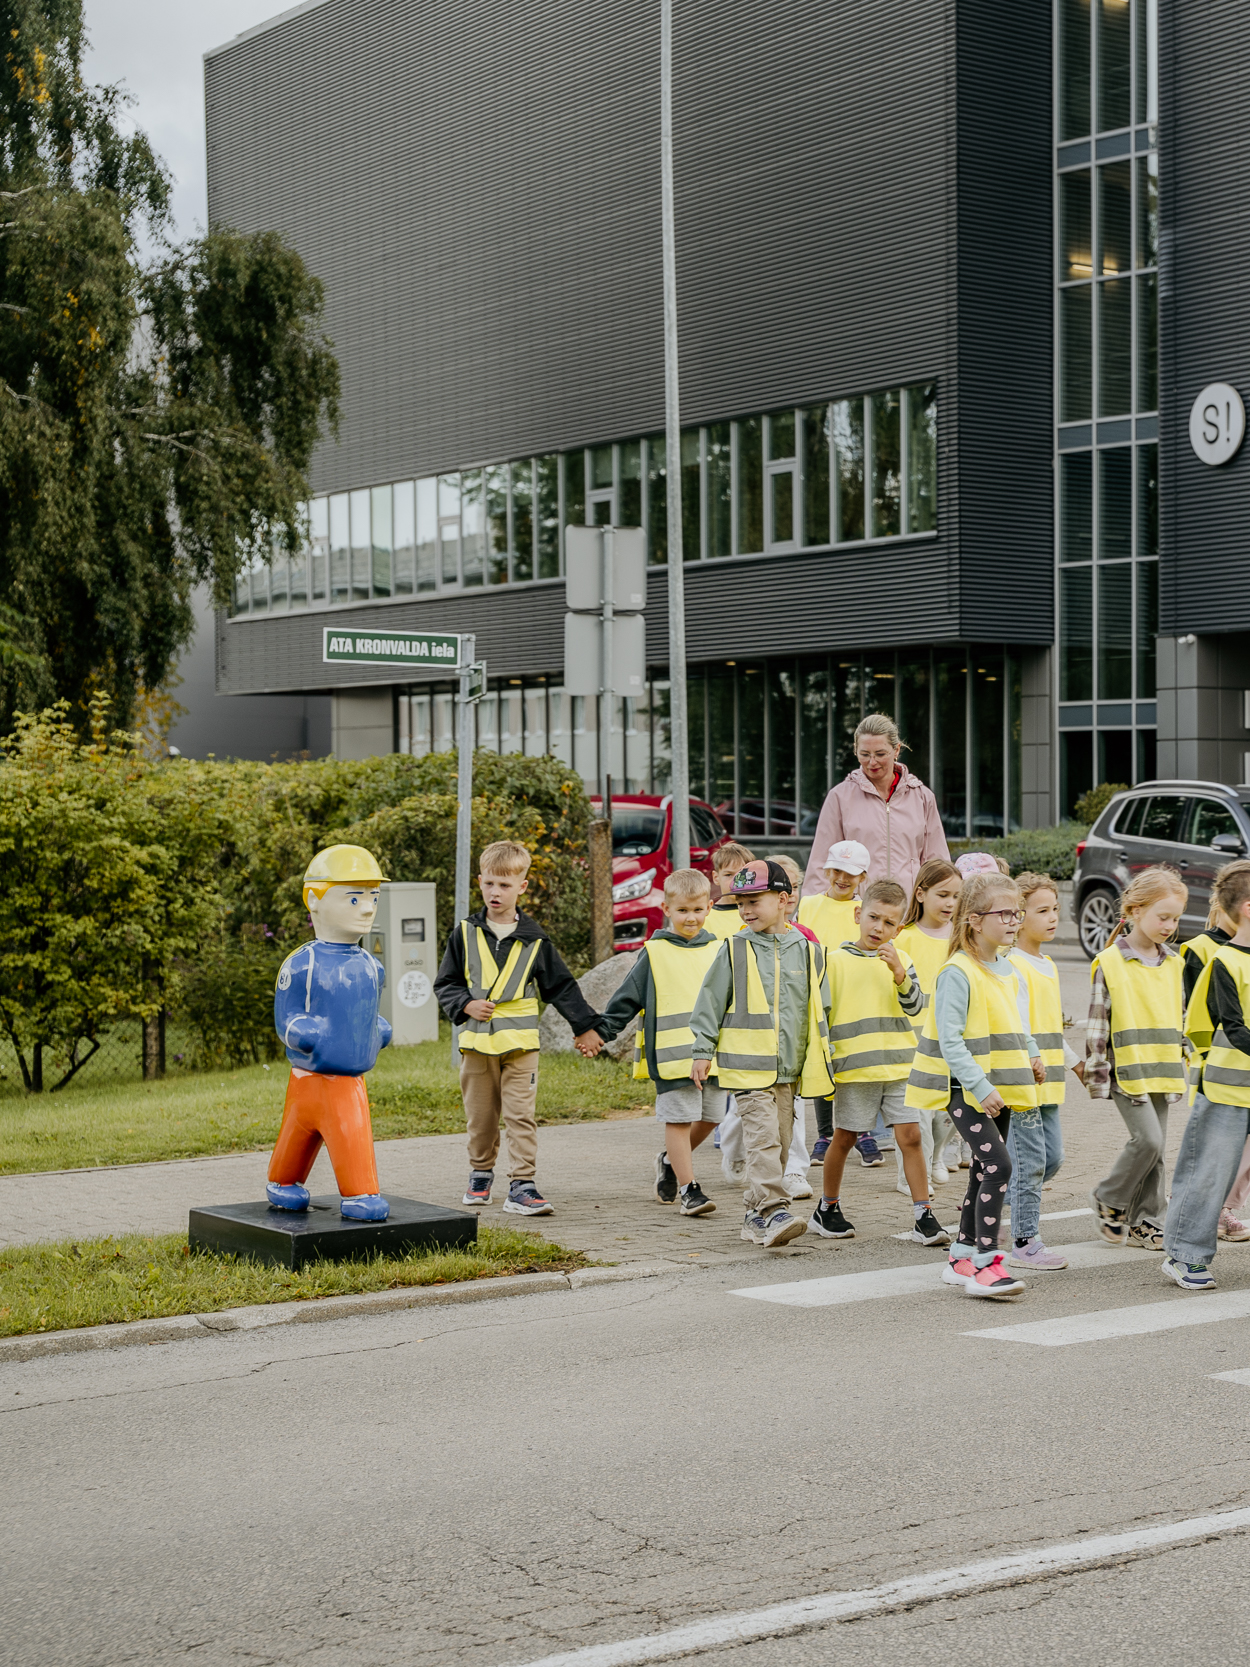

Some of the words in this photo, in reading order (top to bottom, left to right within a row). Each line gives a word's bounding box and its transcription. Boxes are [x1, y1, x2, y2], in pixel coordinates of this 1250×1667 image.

[329, 637, 353, 653] ATA
[356, 638, 429, 657] KRONVALDA
[431, 642, 455, 658] iela
